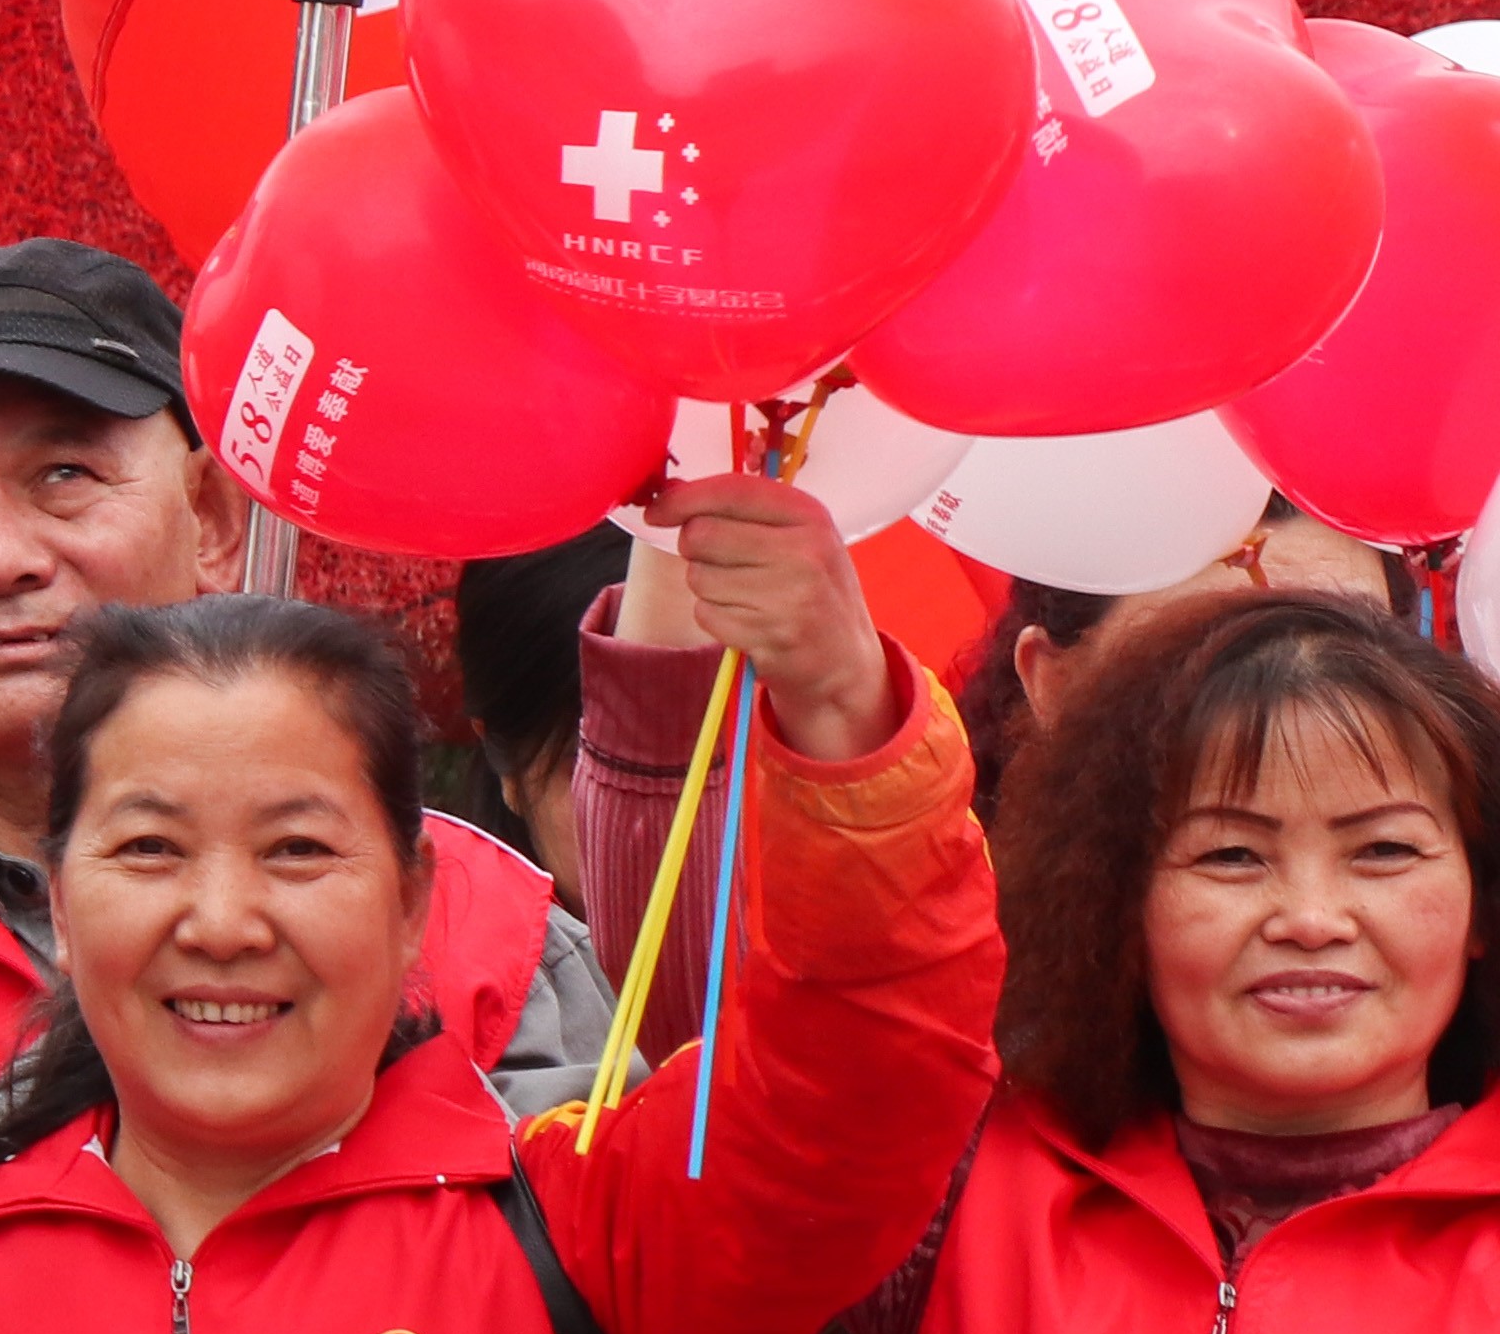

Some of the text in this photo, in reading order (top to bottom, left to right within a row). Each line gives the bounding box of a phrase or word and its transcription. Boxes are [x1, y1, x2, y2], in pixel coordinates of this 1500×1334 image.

[564, 233, 703, 266] HNRCF
[248, 343, 274, 394] 人道
[266, 345, 303, 412] 公益日
[316, 357, 370, 422] 奉献
[296, 423, 338, 481] 博爱
